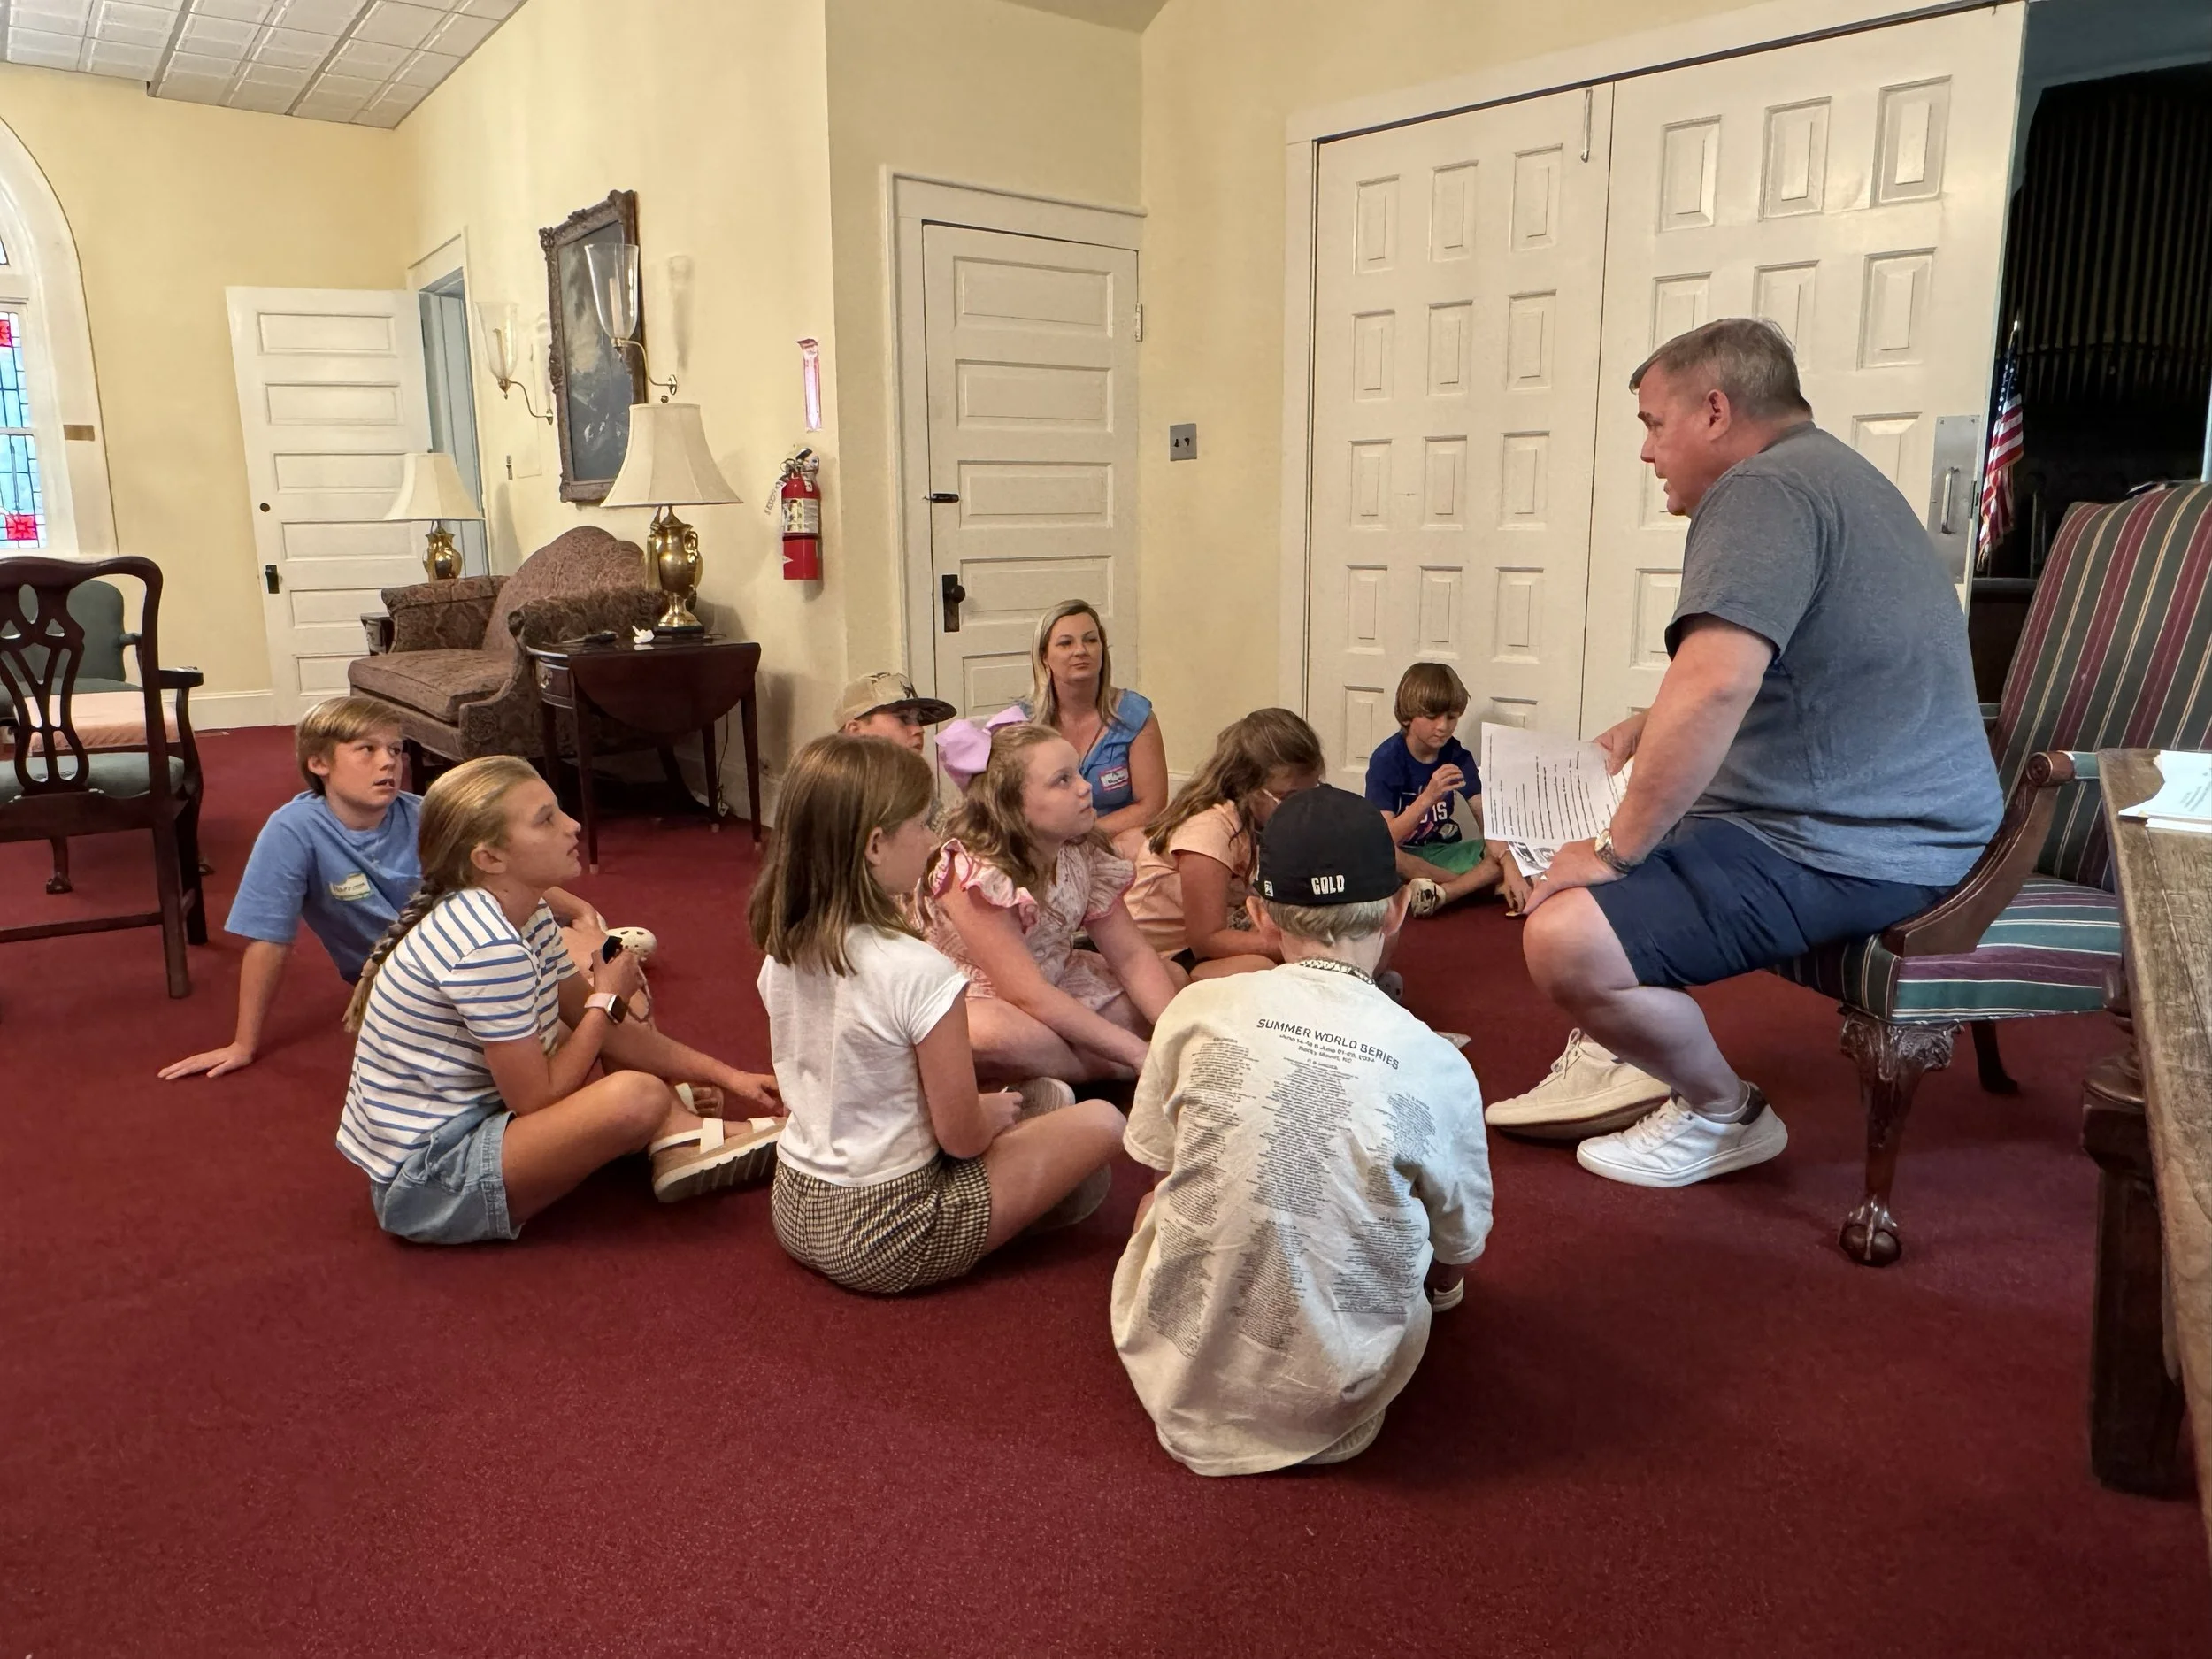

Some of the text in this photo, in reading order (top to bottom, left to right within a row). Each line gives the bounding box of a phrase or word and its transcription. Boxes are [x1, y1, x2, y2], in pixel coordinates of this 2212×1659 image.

[1311, 874, 1345, 895] GOLD
[1256, 1018, 1311, 1038] SUMMER
[1315, 1030, 1357, 1049] WORLD
[1360, 1043, 1399, 1070] SERIES
